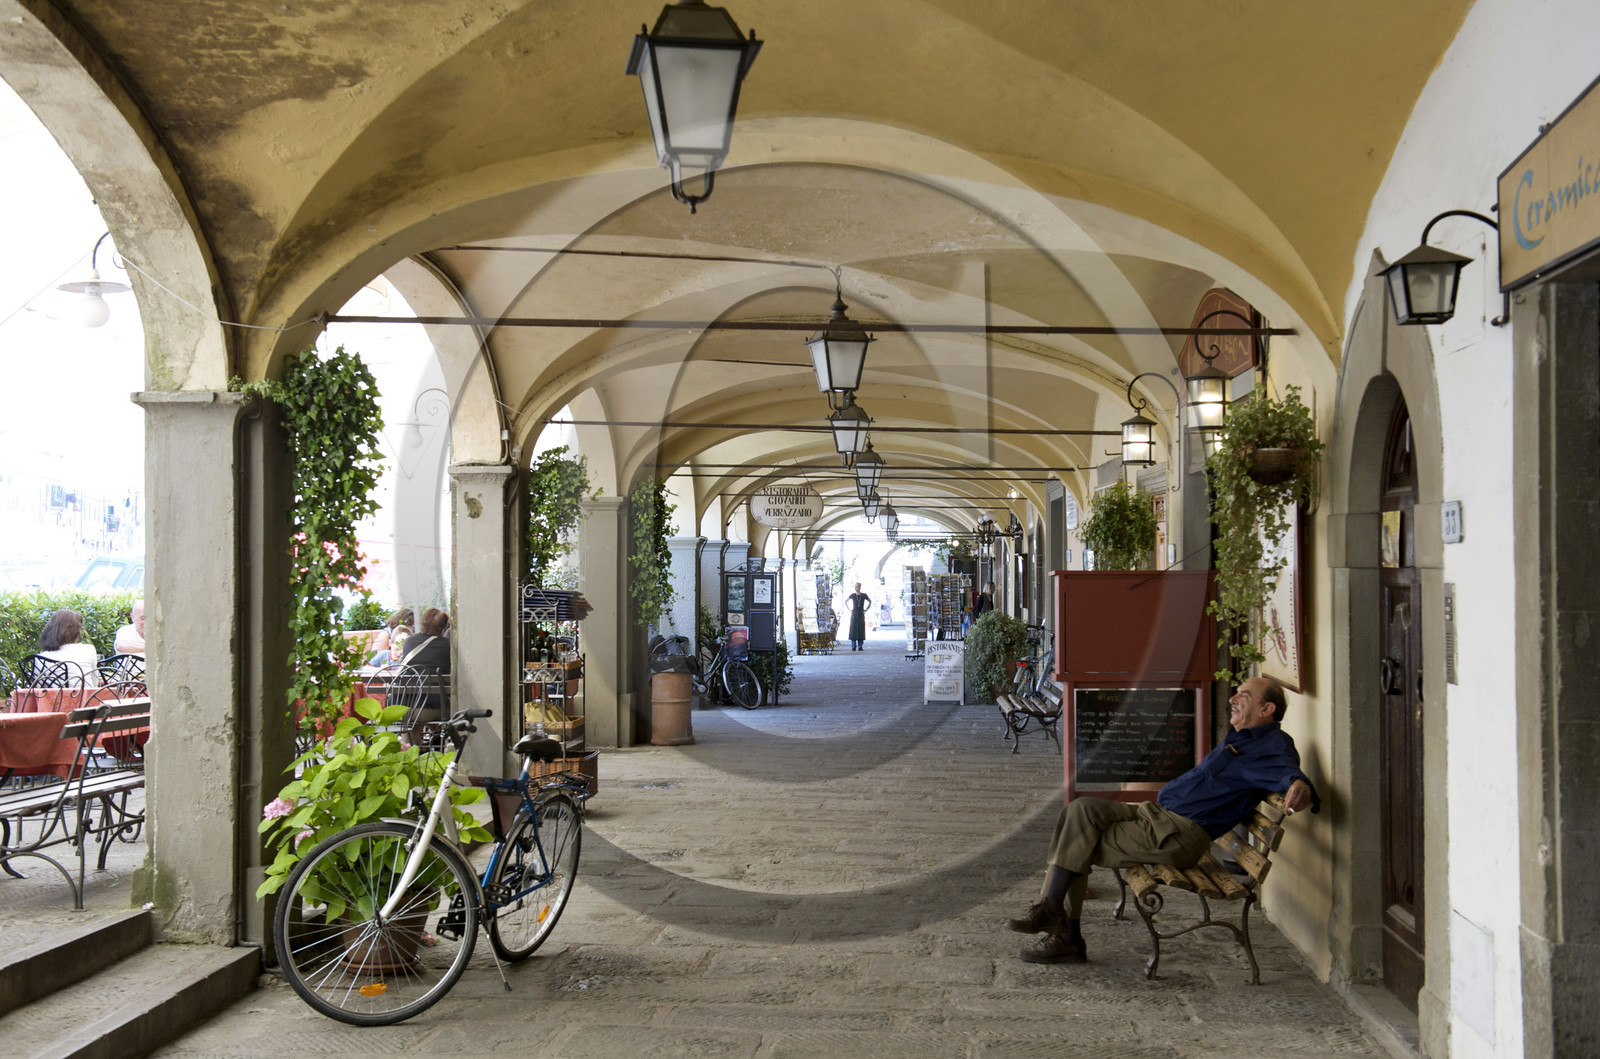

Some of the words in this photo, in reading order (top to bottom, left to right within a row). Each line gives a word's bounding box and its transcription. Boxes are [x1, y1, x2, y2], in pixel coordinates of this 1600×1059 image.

[763, 487, 808, 496] RISTORANTE
[768, 496, 806, 504] GIOVANNI
[765, 508, 812, 517] VERRAZZANO
[927, 643, 962, 656] RISTORANTE
